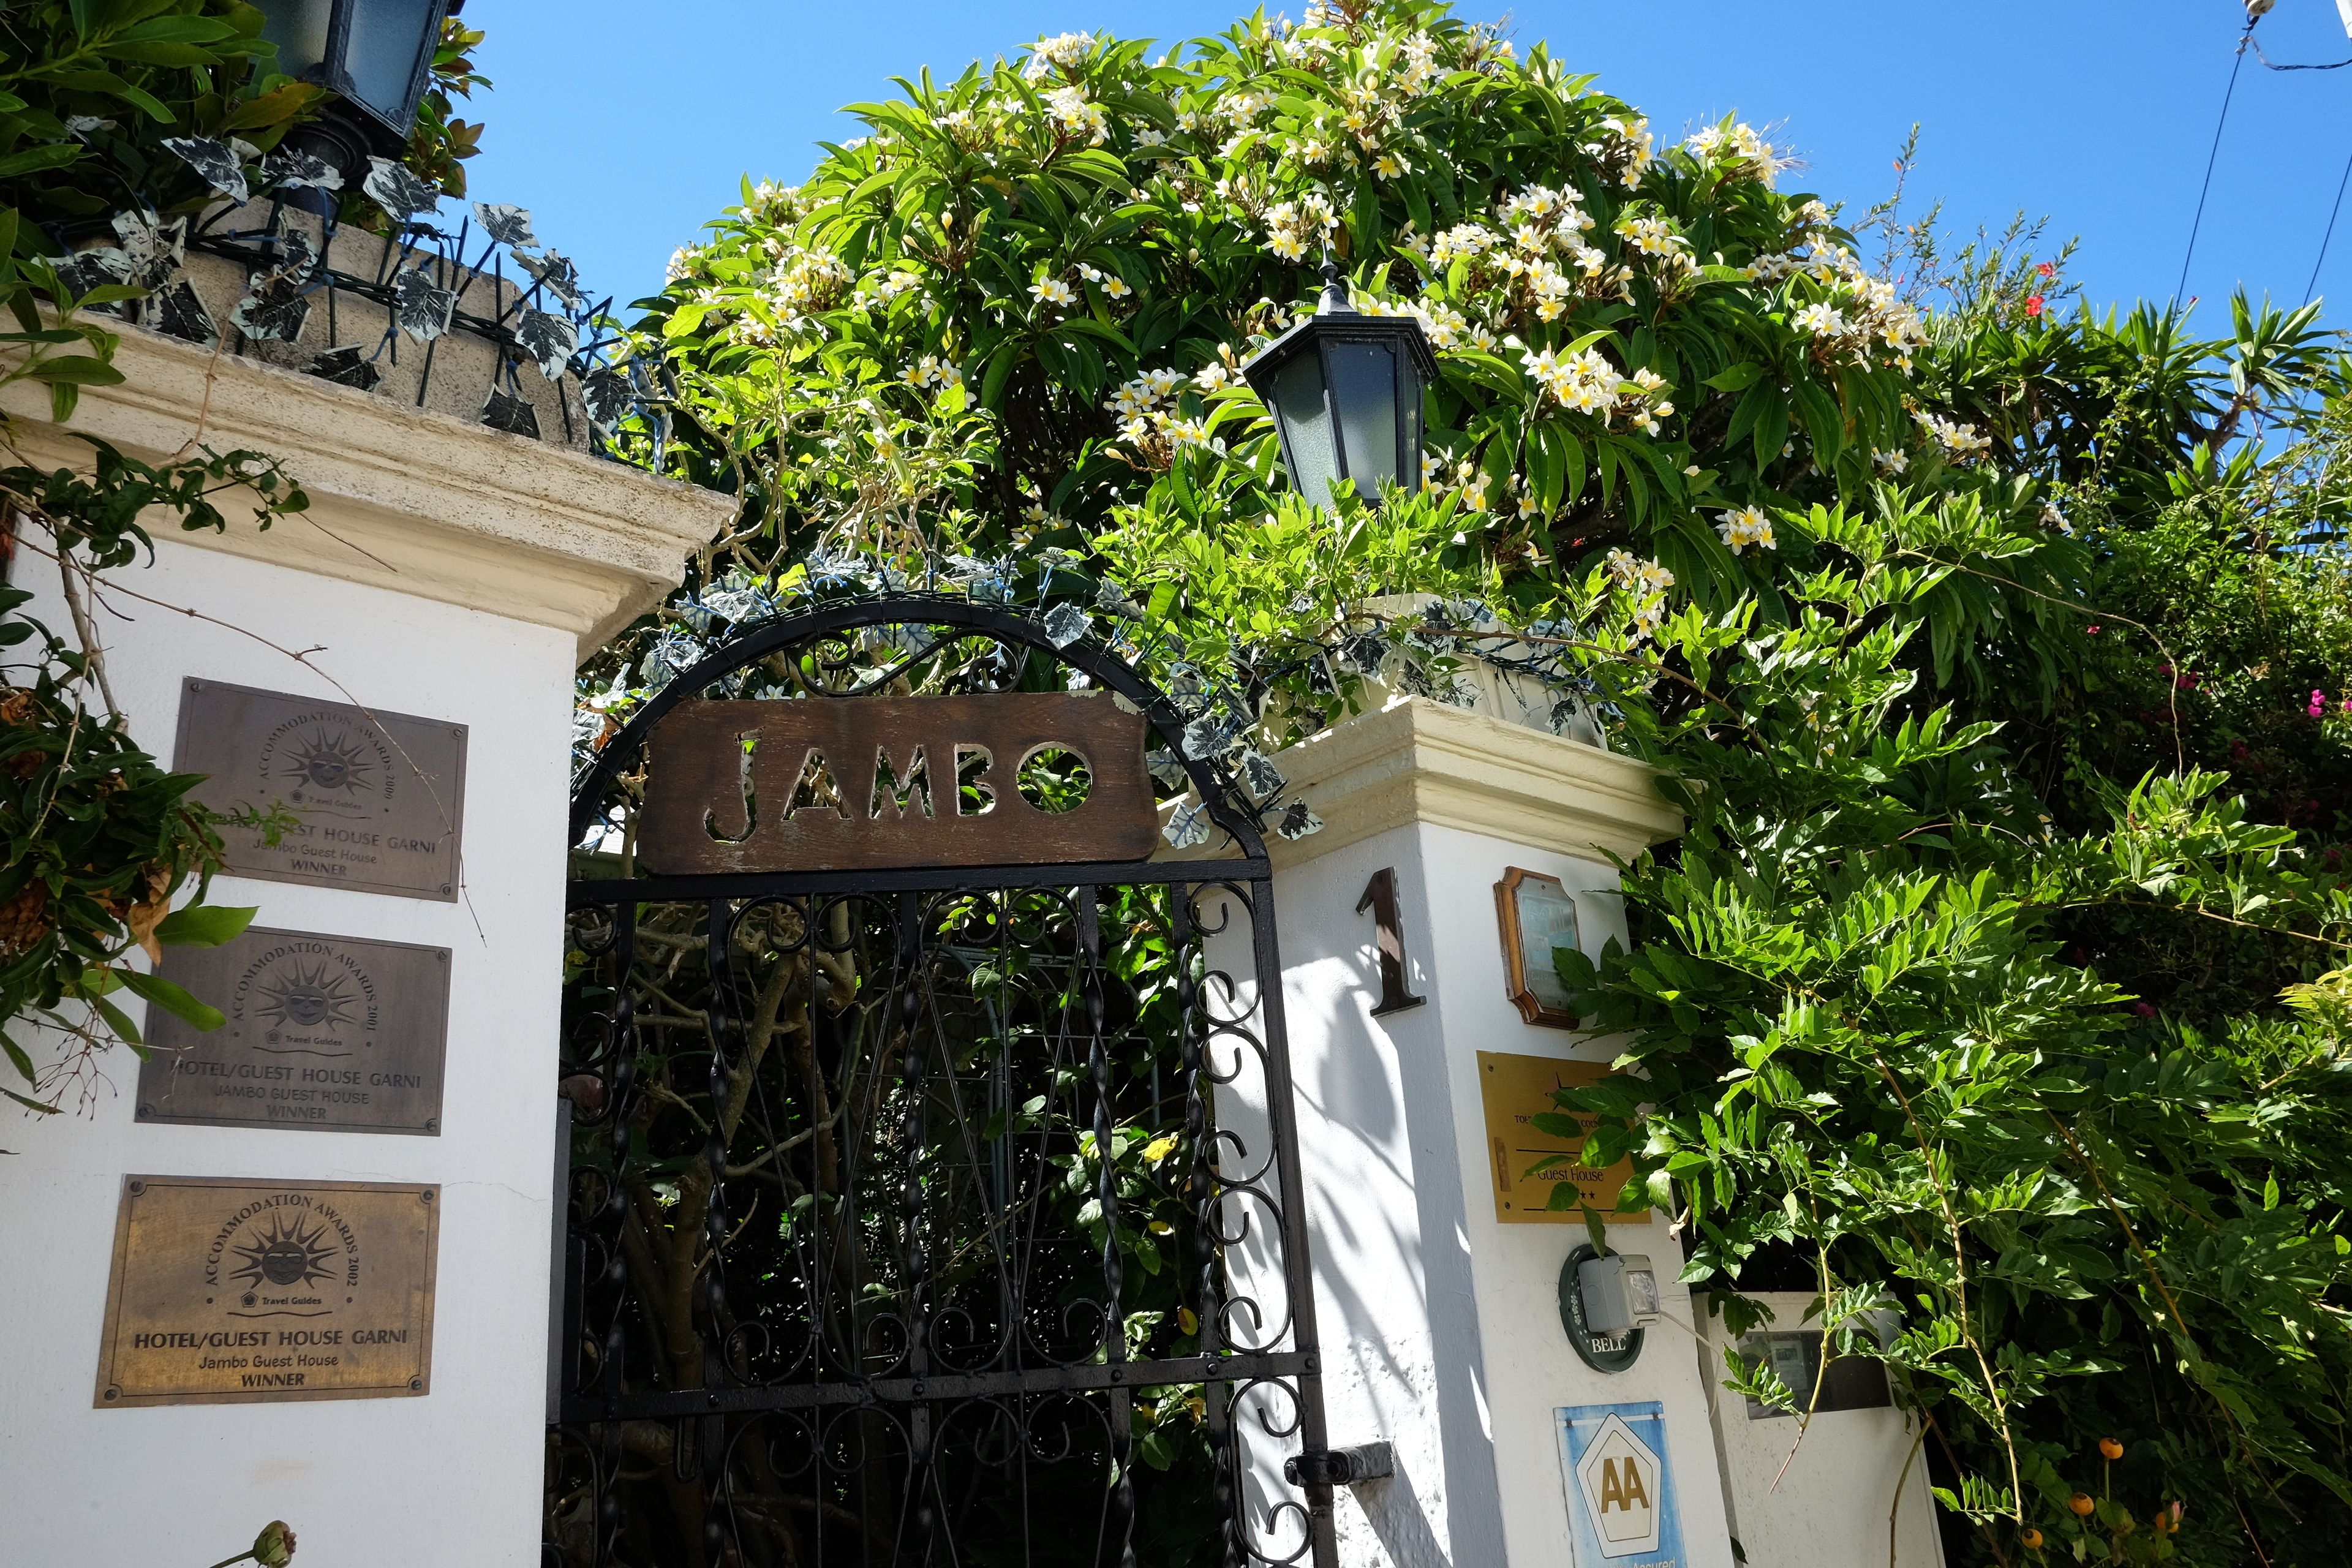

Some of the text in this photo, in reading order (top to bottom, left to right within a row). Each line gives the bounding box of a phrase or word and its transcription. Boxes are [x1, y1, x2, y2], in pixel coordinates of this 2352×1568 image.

[258, 711, 396, 800] ACCOMMODATION AWARDS 2000
[703, 726, 1094, 846] JAMBO
[325, 827, 436, 854] HOUSE GARNI
[301, 844, 336, 859] Guest
[341, 848, 378, 864] House
[290, 858, 348, 876] WINNER
[1355, 865, 1427, 1019] 1
[232, 942, 379, 1031] ACCOMMODATION AWARDS 2001
[285, 1035, 343, 1046] Travel Guides
[170, 1060, 421, 1089] HOTEL/GUEST HOUSE GARNI
[214, 1085, 370, 1104] JAMBO GUEST HOUSE
[266, 1104, 327, 1120] WINNER
[1537, 1168, 1604, 1182] Guest House
[205, 1194, 360, 1287] ACCOMMODATION AWARDS 2002
[262, 1295, 322, 1306] Travel Guides
[134, 1329, 407, 1350] HOTEL/GUEST HOUSE GARNI
[1591, 1337, 1626, 1354] BELL
[198, 1354, 339, 1370] Jambo Guest House
[241, 1373, 305, 1388] WINNER
[1600, 1456, 1650, 1514] AA
